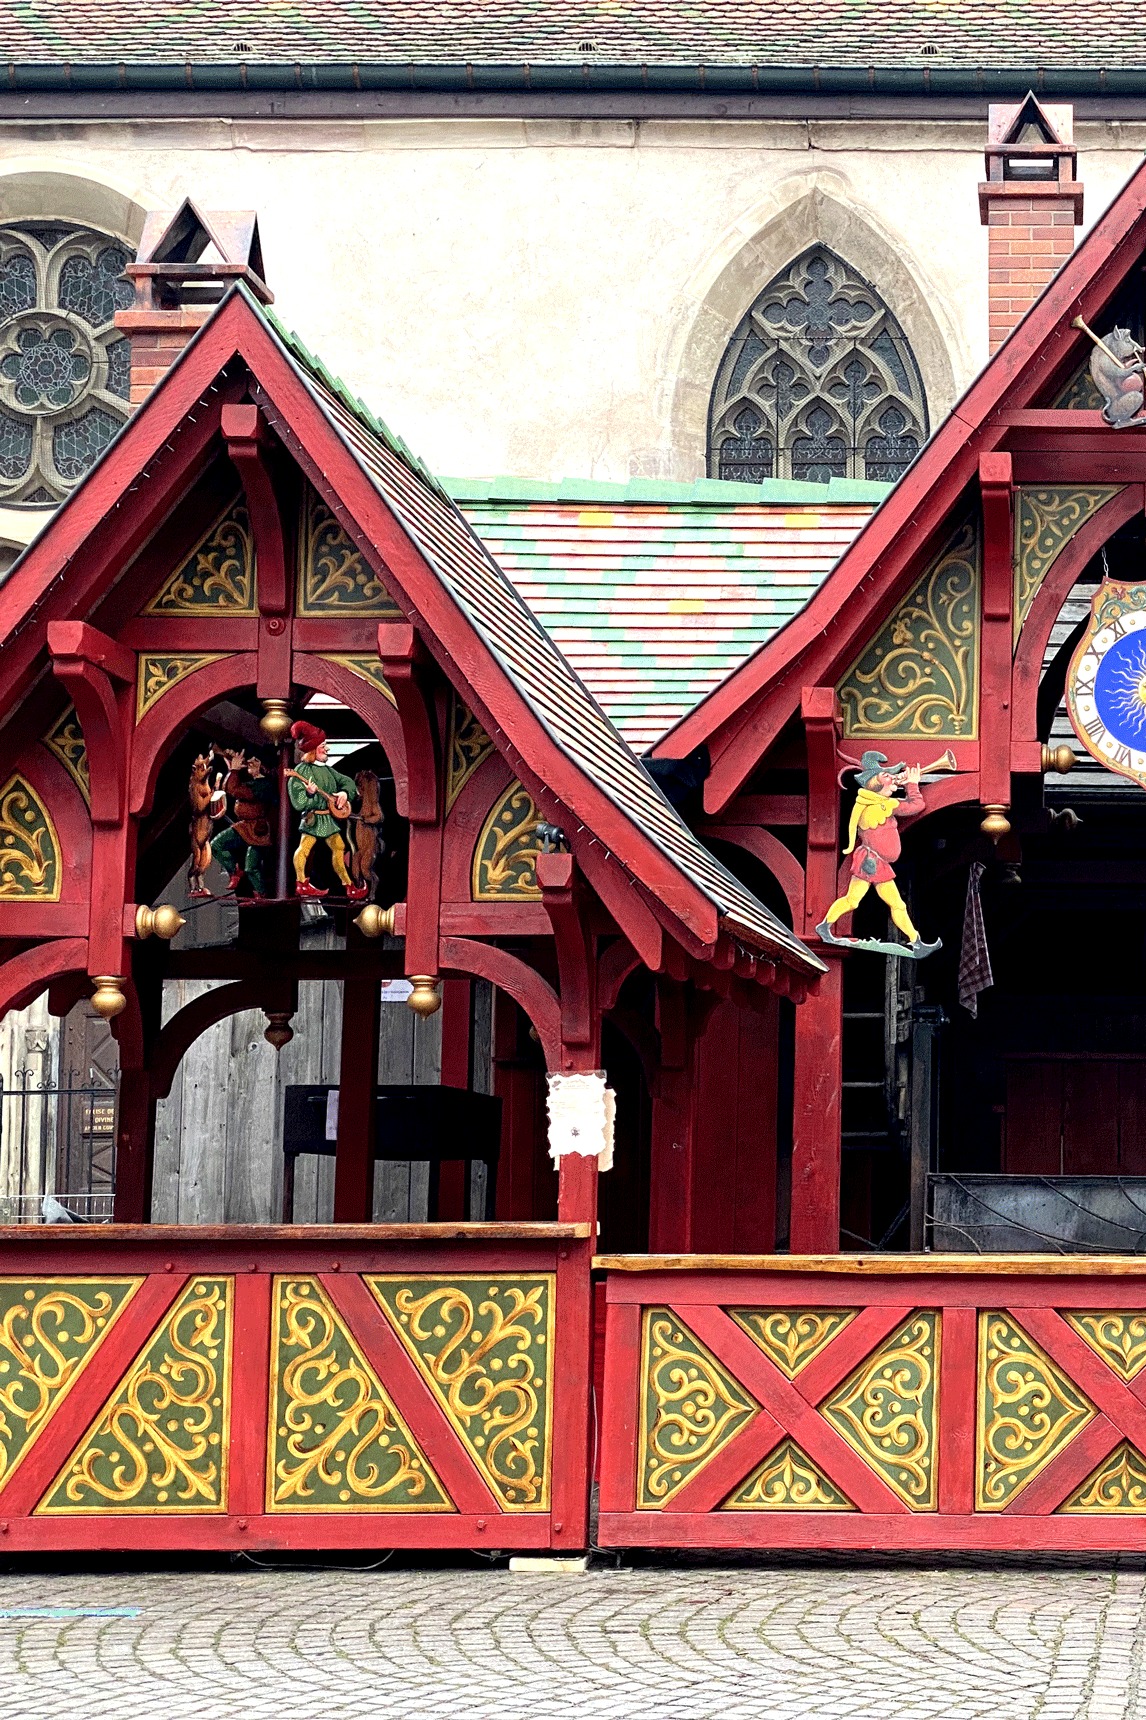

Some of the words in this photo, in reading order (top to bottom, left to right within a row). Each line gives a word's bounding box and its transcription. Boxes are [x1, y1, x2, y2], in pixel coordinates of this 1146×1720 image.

[1105, 618, 1127, 642] XI
[1084, 643, 1107, 665] X
[1075, 677, 1094, 697] IX
[1083, 716, 1106, 745] VIII
[1113, 744, 1132, 771] VII
